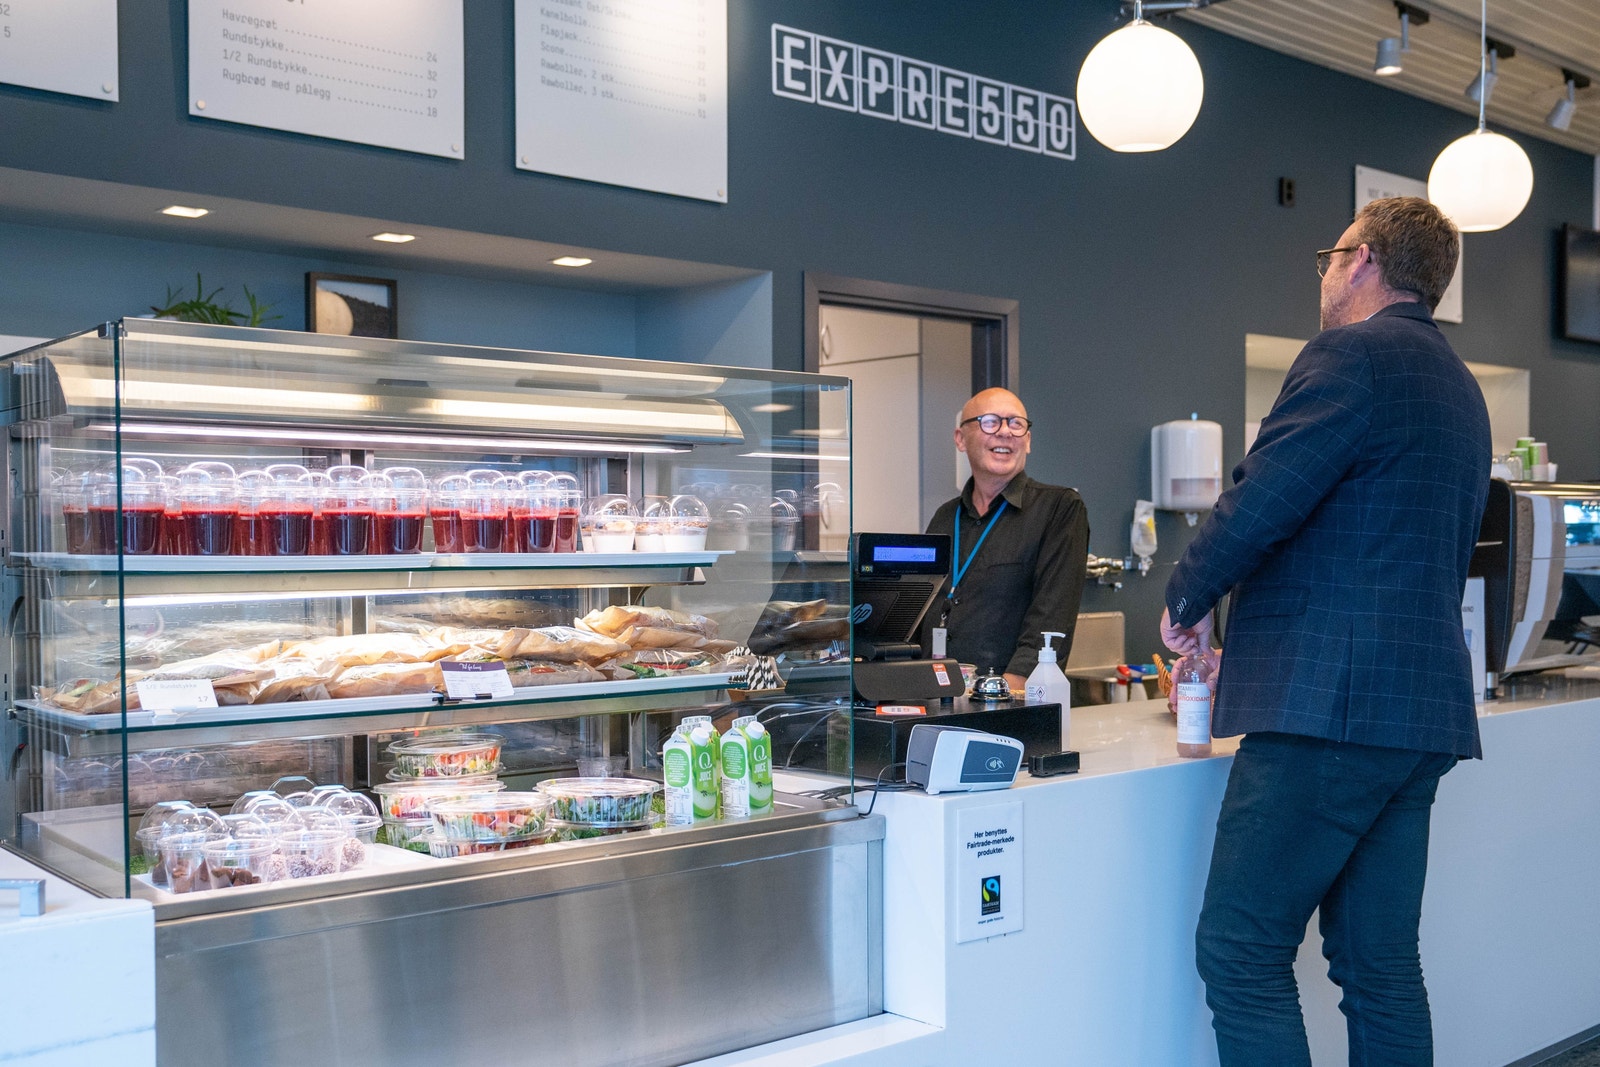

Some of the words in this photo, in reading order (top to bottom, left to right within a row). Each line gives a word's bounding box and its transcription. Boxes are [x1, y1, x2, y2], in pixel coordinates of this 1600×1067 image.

[540, 7, 587, 27] Kanelbolle
[222, 8, 277, 30] Havregrøt
[427, 51, 438, 63] 24
[222, 28, 284, 51] Rundstykke
[541, 41, 565, 53] Scone
[223, 48, 241, 62] 1/2
[247, 53, 308, 75] Rundstykke
[427, 88, 438, 99] 17
[222, 68, 266, 87] Rugbrød
[271, 79, 290, 91] med
[295, 83, 331, 100] pålegg
[698, 751, 713, 770] Q
[753, 744, 768, 761] Q
[966, 836, 1015, 849] Fairtrade-merkede
[974, 831, 984, 839] Her
[984, 828, 1007, 838] benyttes
[977, 847, 1005, 858] produkter.
